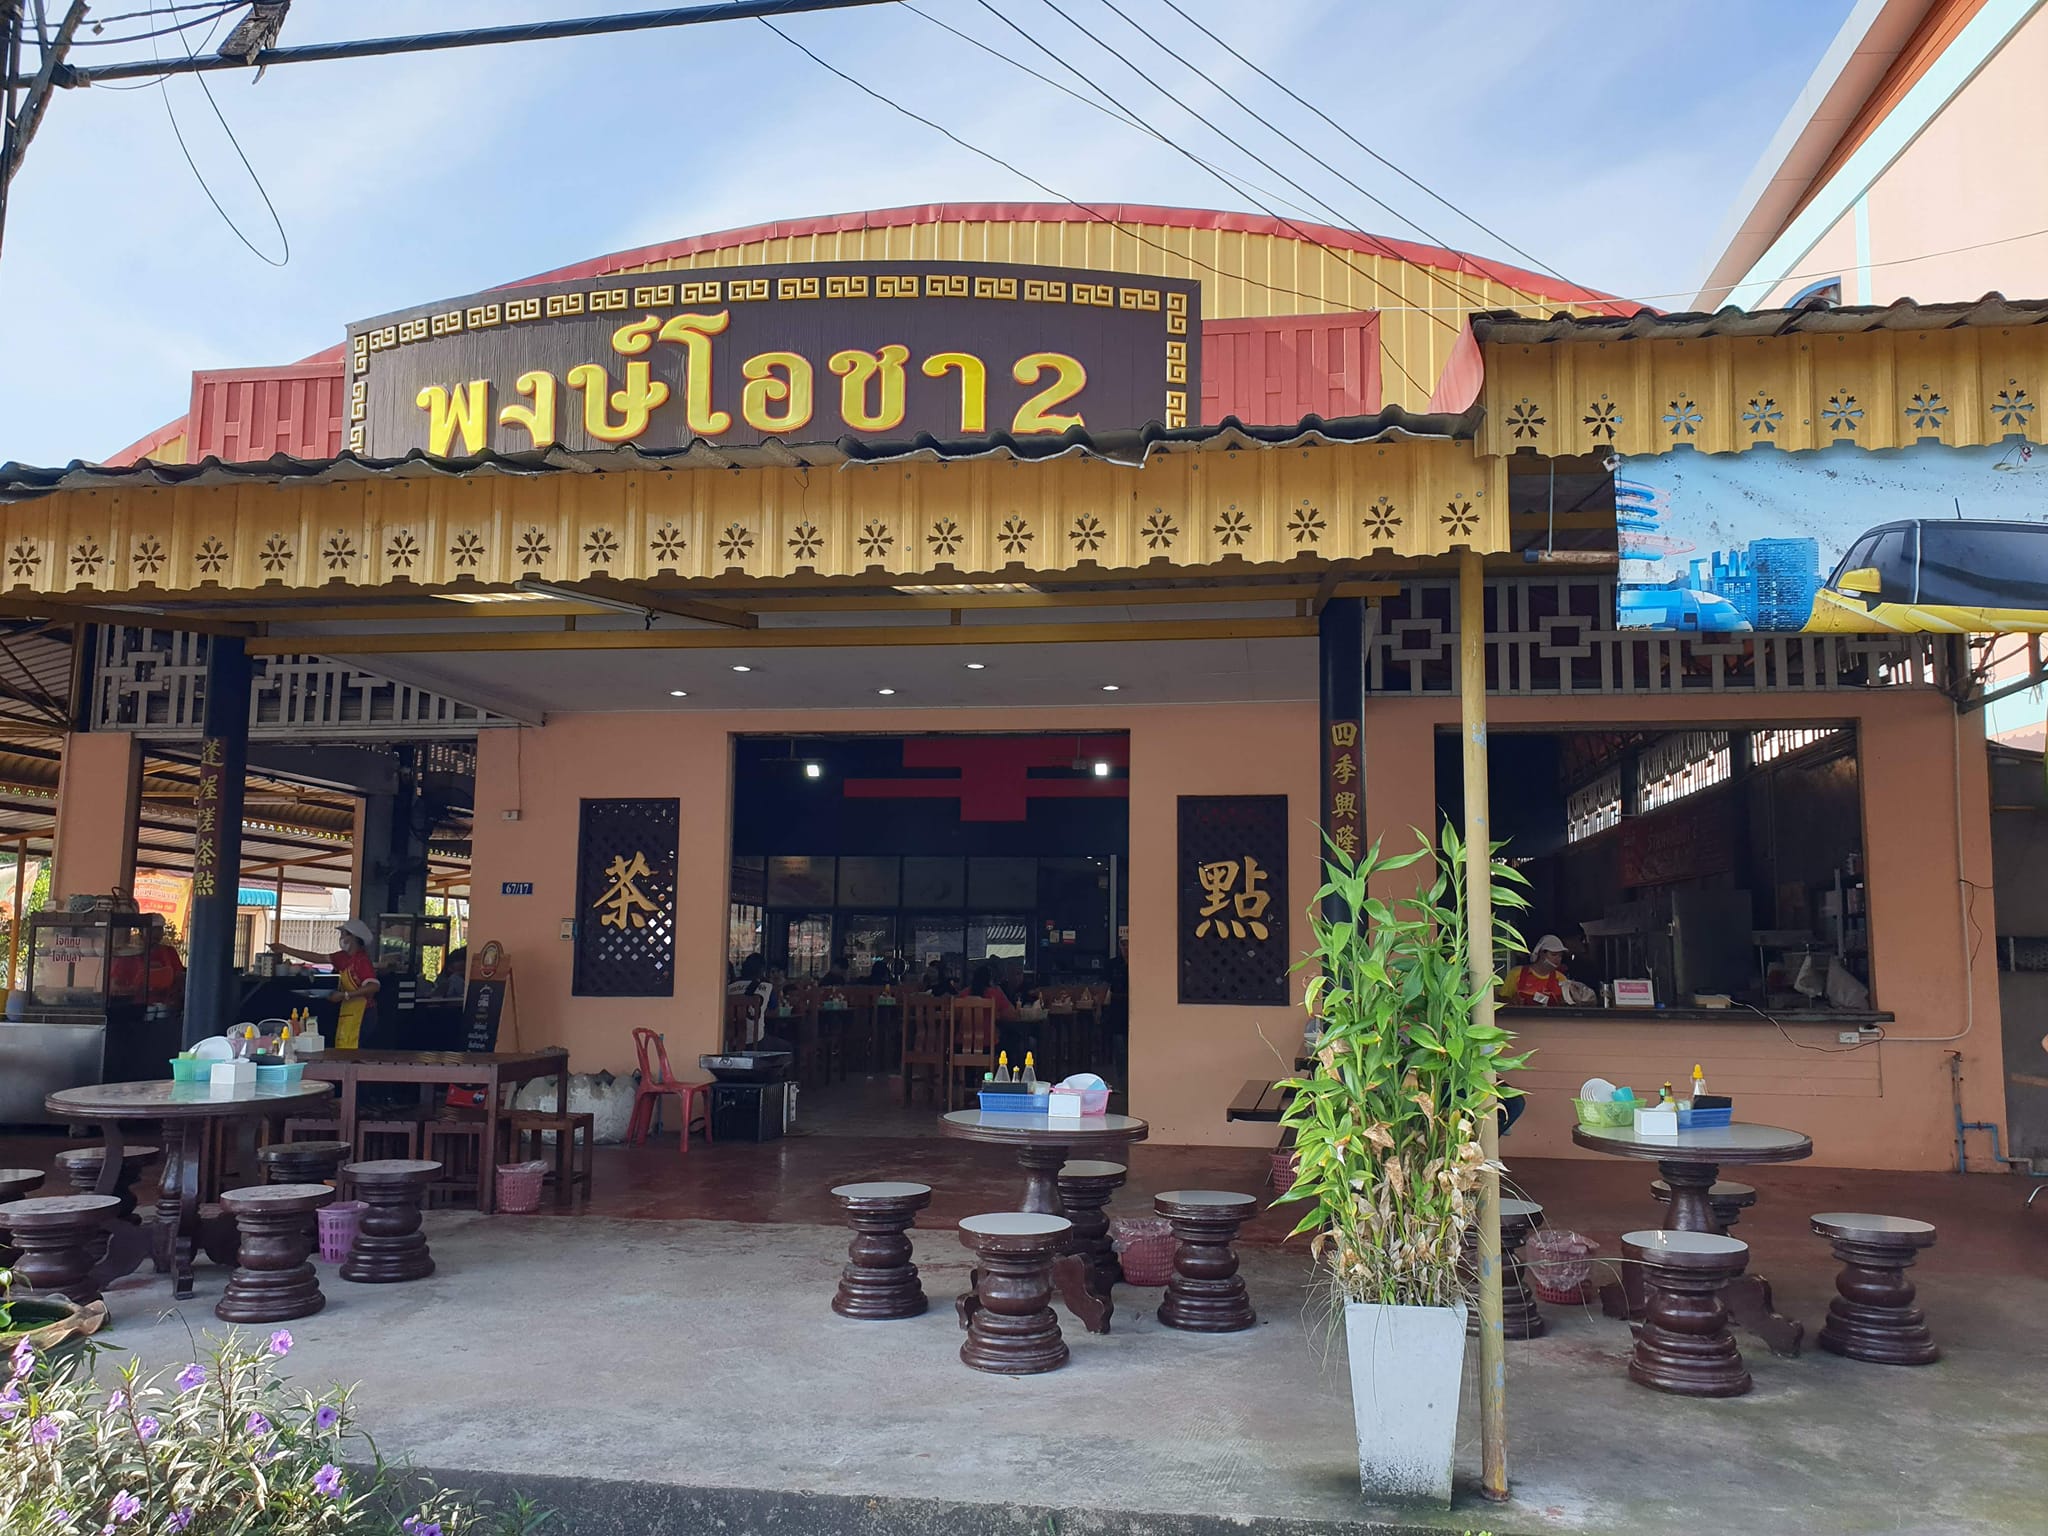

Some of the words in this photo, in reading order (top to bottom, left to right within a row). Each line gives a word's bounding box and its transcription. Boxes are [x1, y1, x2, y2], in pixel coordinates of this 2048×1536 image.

[1331, 722, 1359, 855] 四季興隆
[505, 883, 529, 895] 67/17
[593, 851, 662, 930] 茶
[1195, 855, 1271, 941] 點
